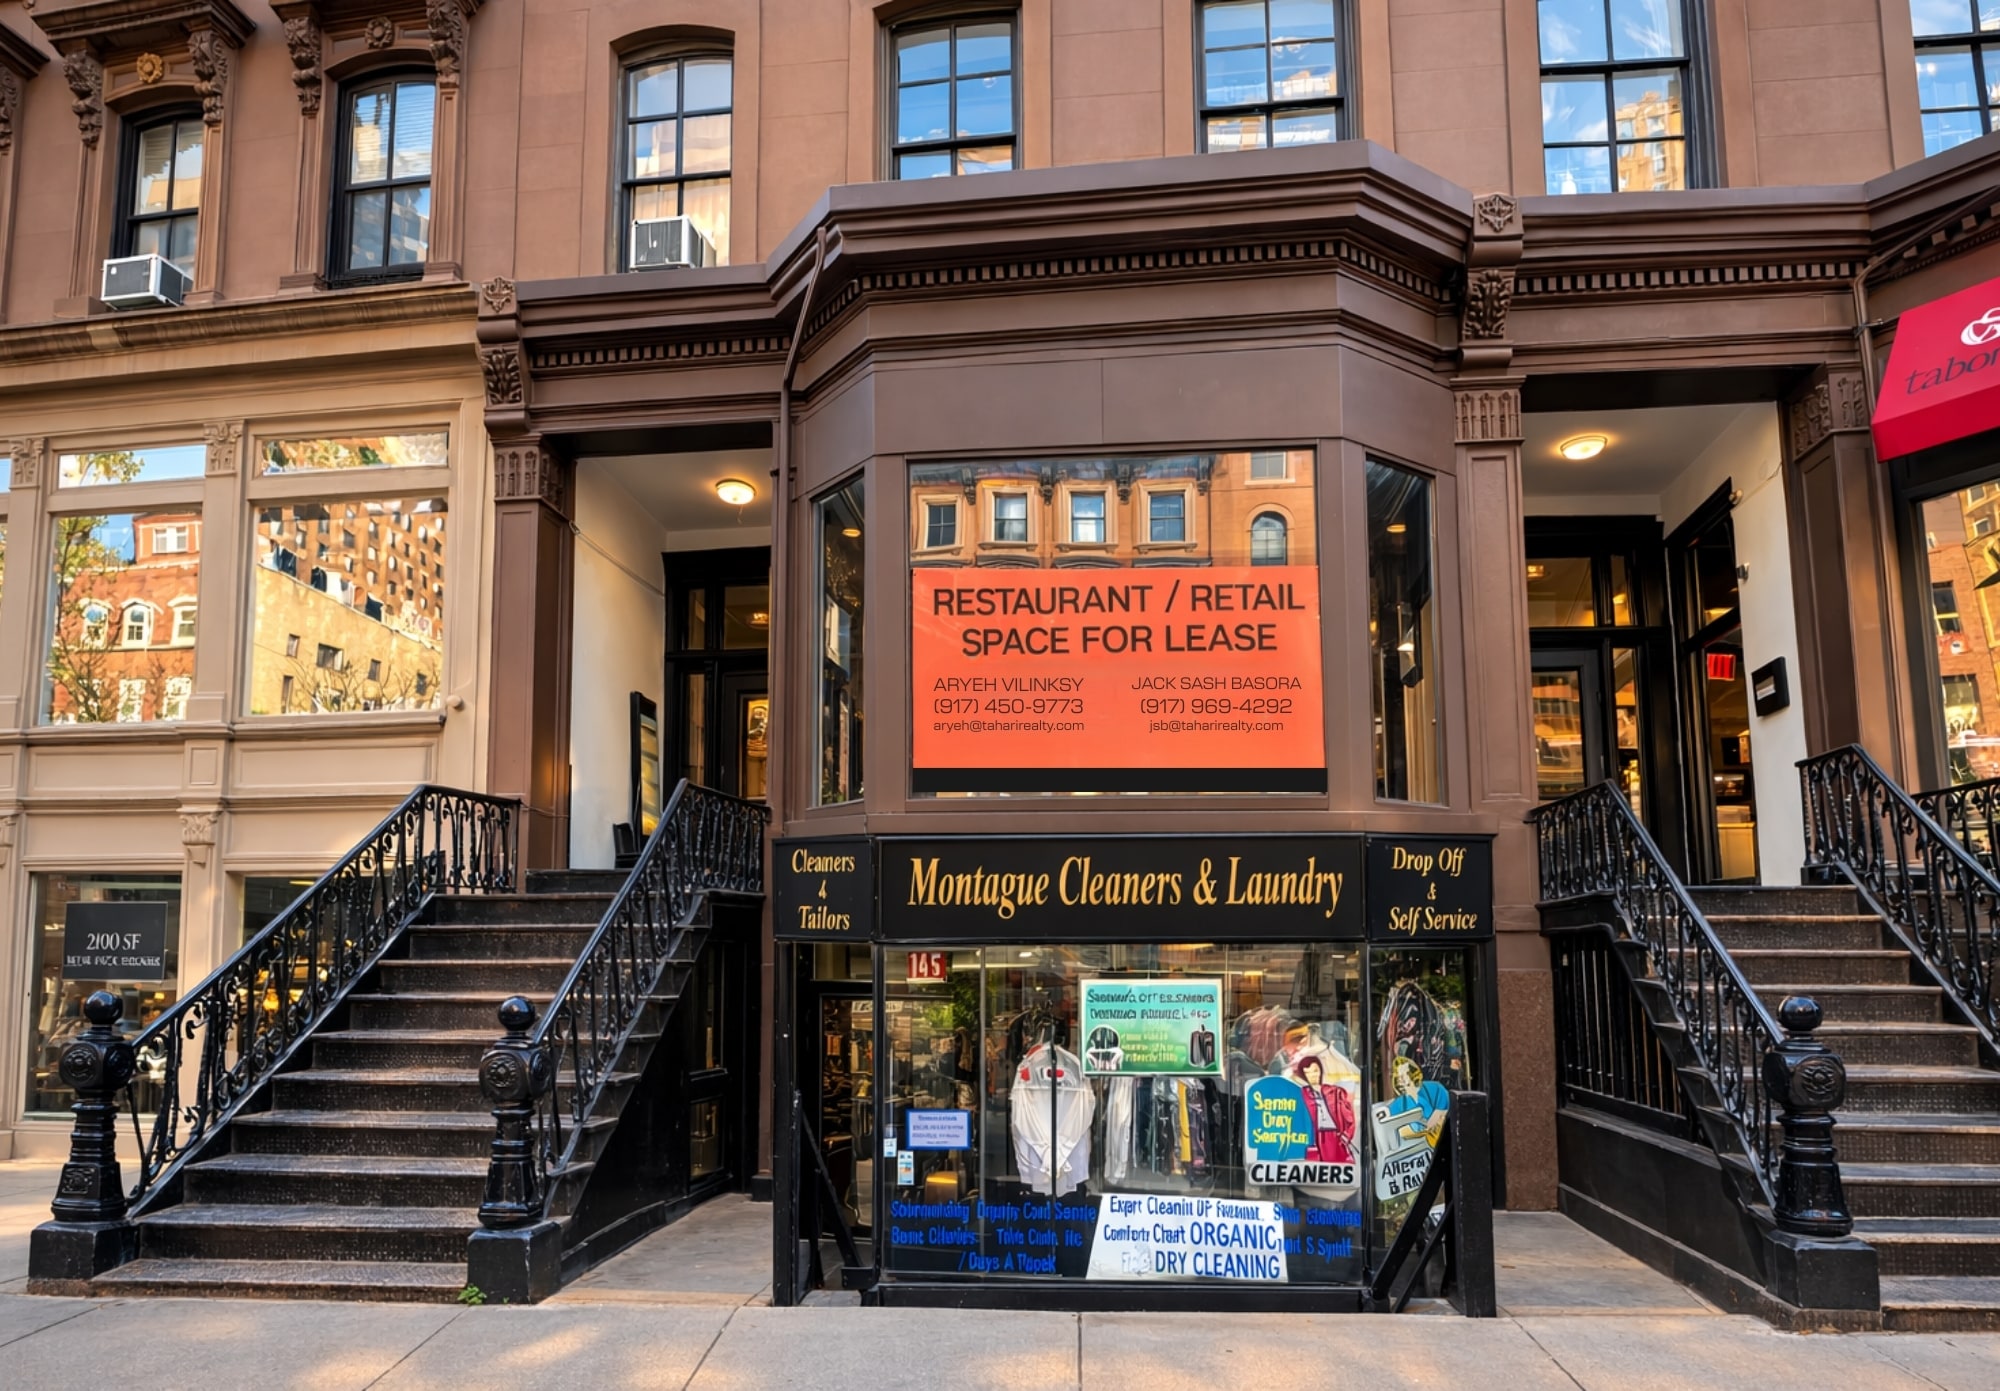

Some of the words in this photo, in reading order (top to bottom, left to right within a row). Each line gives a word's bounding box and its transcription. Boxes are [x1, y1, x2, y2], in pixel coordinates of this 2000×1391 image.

[933, 585, 1153, 616] RESTAURANT
[1165, 579, 1180, 613] /
[1191, 583, 1306, 611] RETAIL
[962, 626, 1070, 657] SPACE
[1082, 625, 1152, 654] FOR
[1165, 624, 1278, 652] LEASE
[933, 677, 997, 692] ARYEH
[1001, 677, 1085, 692] VILINKSY
[1131, 676, 1177, 690] JACK
[1180, 676, 1227, 690] SASH
[1231, 676, 1302, 690] BASORA
[934, 698, 979, 714] (917)
[984, 698, 1084, 714] 450-9773
[1140, 698, 1185, 714] (917)
[1191, 698, 1293, 714] 969-4292
[933, 719, 1085, 733] aryeh@taharirealty.com
[1149, 719, 1284, 733] jsb@taharirealty.com
[1392, 847, 1433, 877] Drop
[1438, 847, 1467, 877] Off
[907, 857, 1050, 919] Montague
[1059, 856, 1182, 906] Cleaners
[1193, 857, 1217, 905] &
[1225, 856, 1344, 919] Laundry
[797, 905, 850, 930] Tailors
[1388, 906, 1422, 936] Self
[1423, 906, 1478, 930] Service
[86, 933, 120, 951] 2100
[122, 933, 142, 951] SF
[910, 952, 941, 978] 145
[1251, 1164, 1354, 1184] CLEANERS
[1190, 1221, 1277, 1250] ORGANIC
[1155, 1250, 1187, 1275] DRY
[1193, 1252, 1280, 1279] CLEANING
